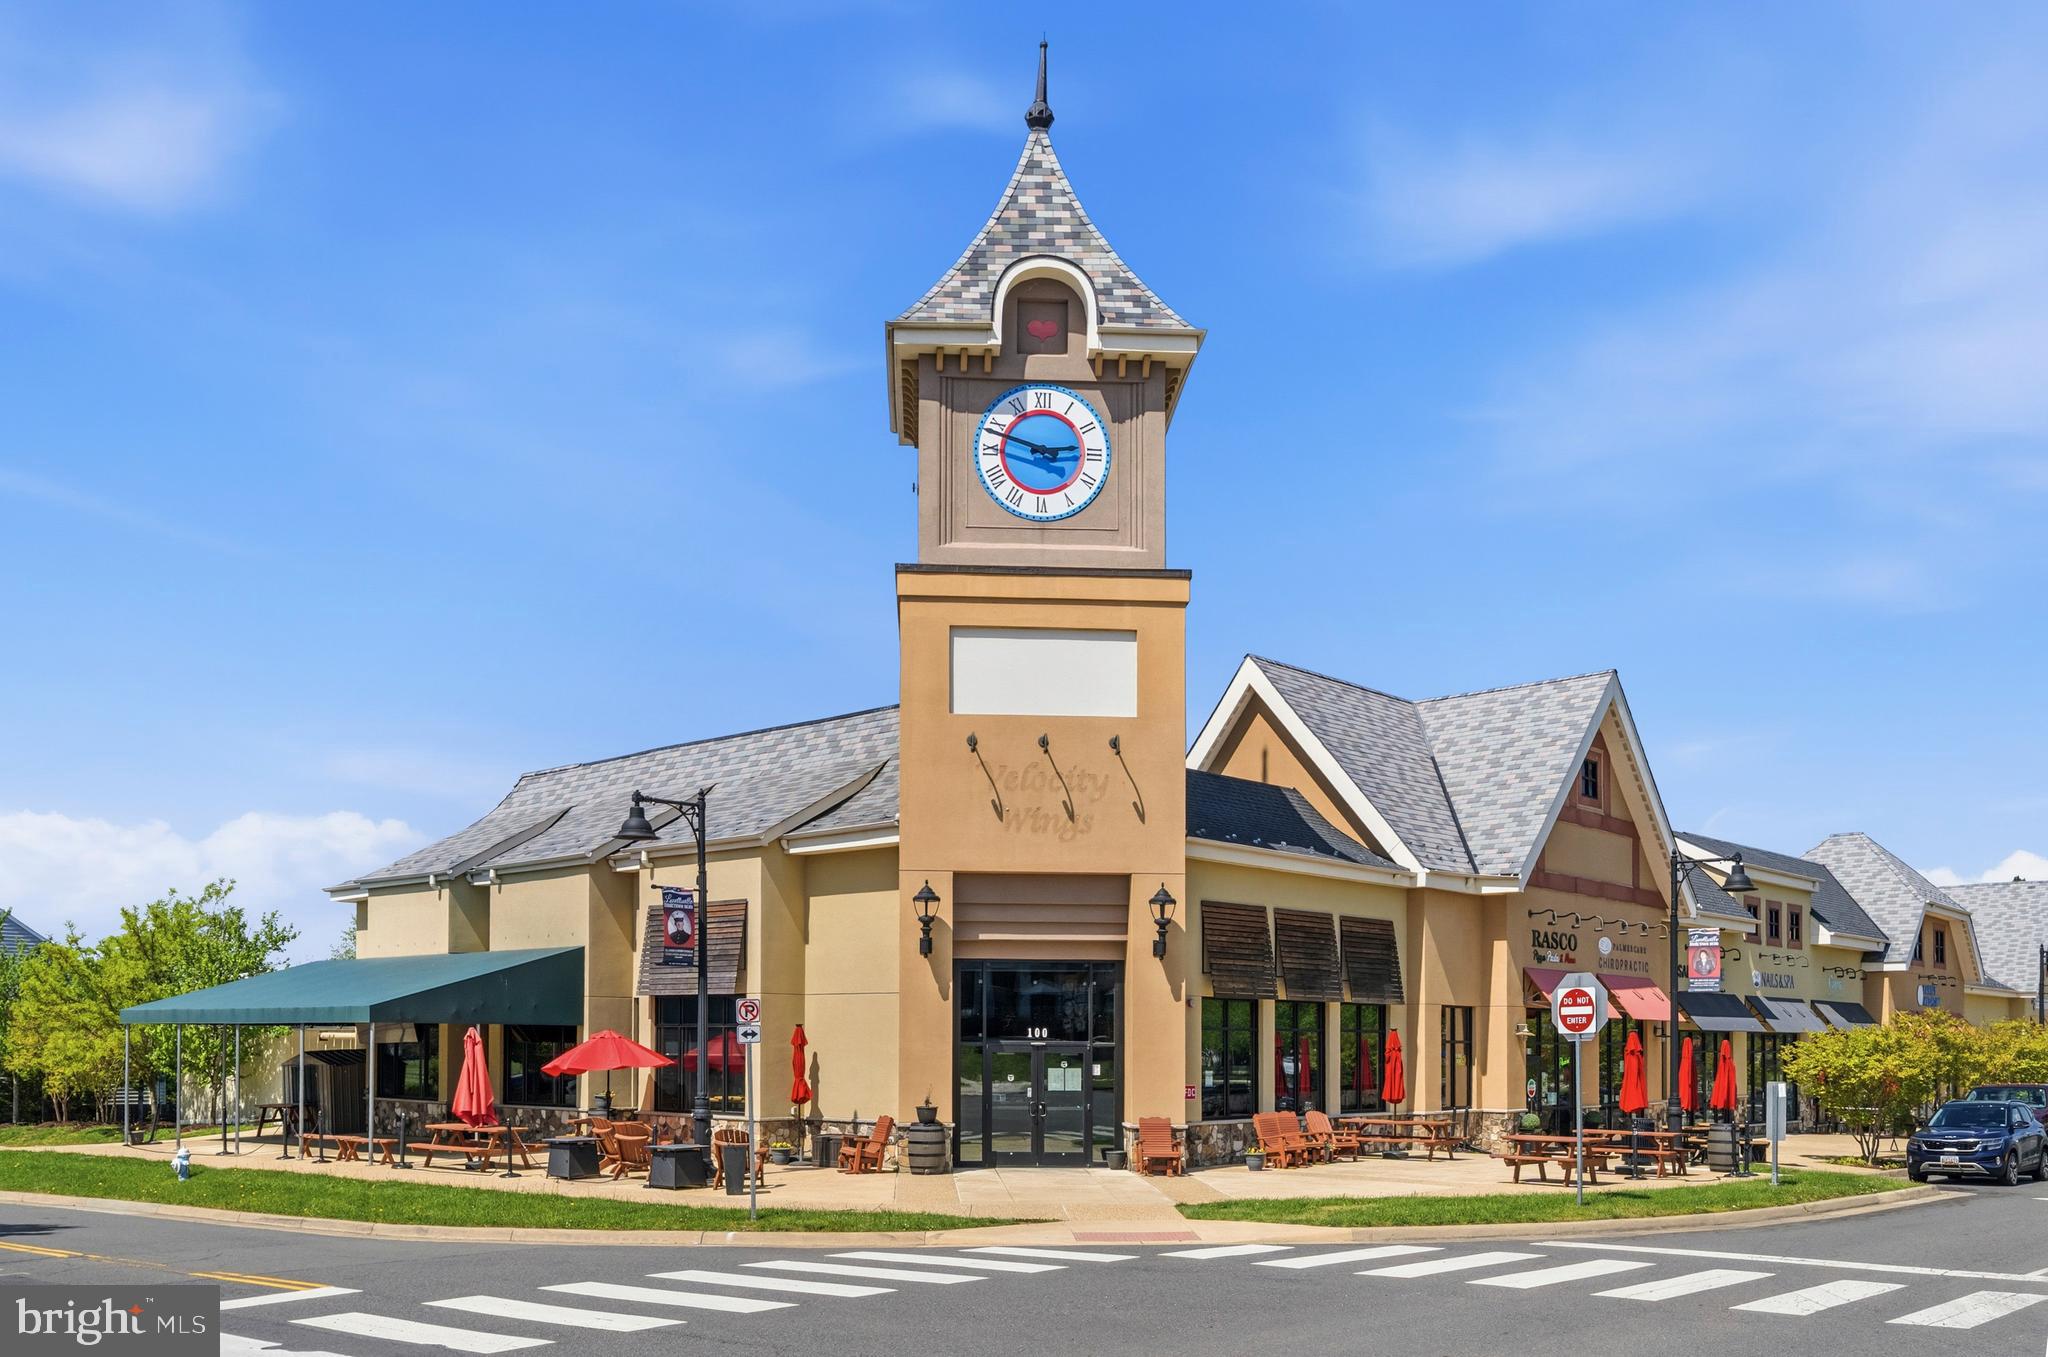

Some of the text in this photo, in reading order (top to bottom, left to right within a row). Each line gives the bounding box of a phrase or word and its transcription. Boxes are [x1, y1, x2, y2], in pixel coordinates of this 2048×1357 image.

[1008, 397, 1025, 416] XI
[1035, 392, 1051, 408] XII
[1064, 402, 1074, 415] I
[990, 418, 1006, 431] X
[1080, 422, 1096, 434] II
[983, 443, 999, 456] IX
[1087, 448, 1102, 461] III
[986, 464, 1007, 489] VIII
[1080, 472, 1096, 490] IV
[1005, 486, 1024, 507] VII
[1036, 496, 1048, 513] VI
[1064, 492, 1074, 507] V
[977, 760, 1109, 802] Velocity
[1004, 806, 1094, 842] Wings
[1532, 930, 1577, 951] RASCO
[1598, 957, 1648, 973] CHIROPRACTIC
[1027, 1028, 1048, 1038] 100
